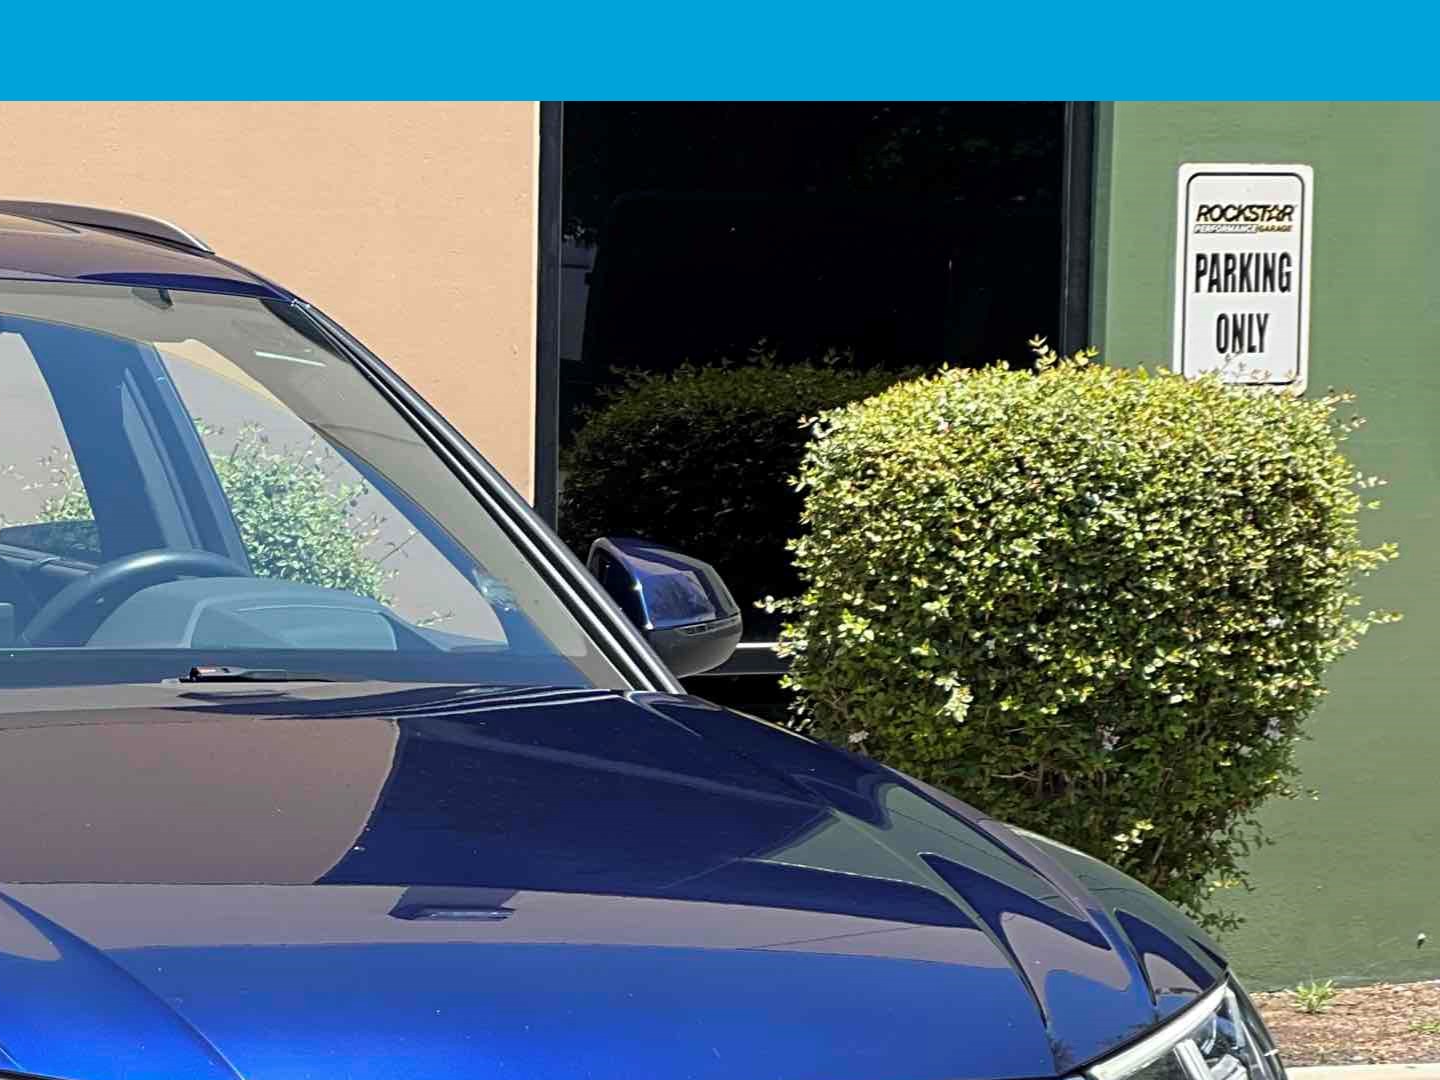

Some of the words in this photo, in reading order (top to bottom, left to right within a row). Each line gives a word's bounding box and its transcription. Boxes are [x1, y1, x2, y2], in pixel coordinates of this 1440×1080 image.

[1196, 203, 1295, 222] ROCKSTAR
[1194, 252, 1292, 293] PARKING
[1216, 313, 1269, 353] ONLY
